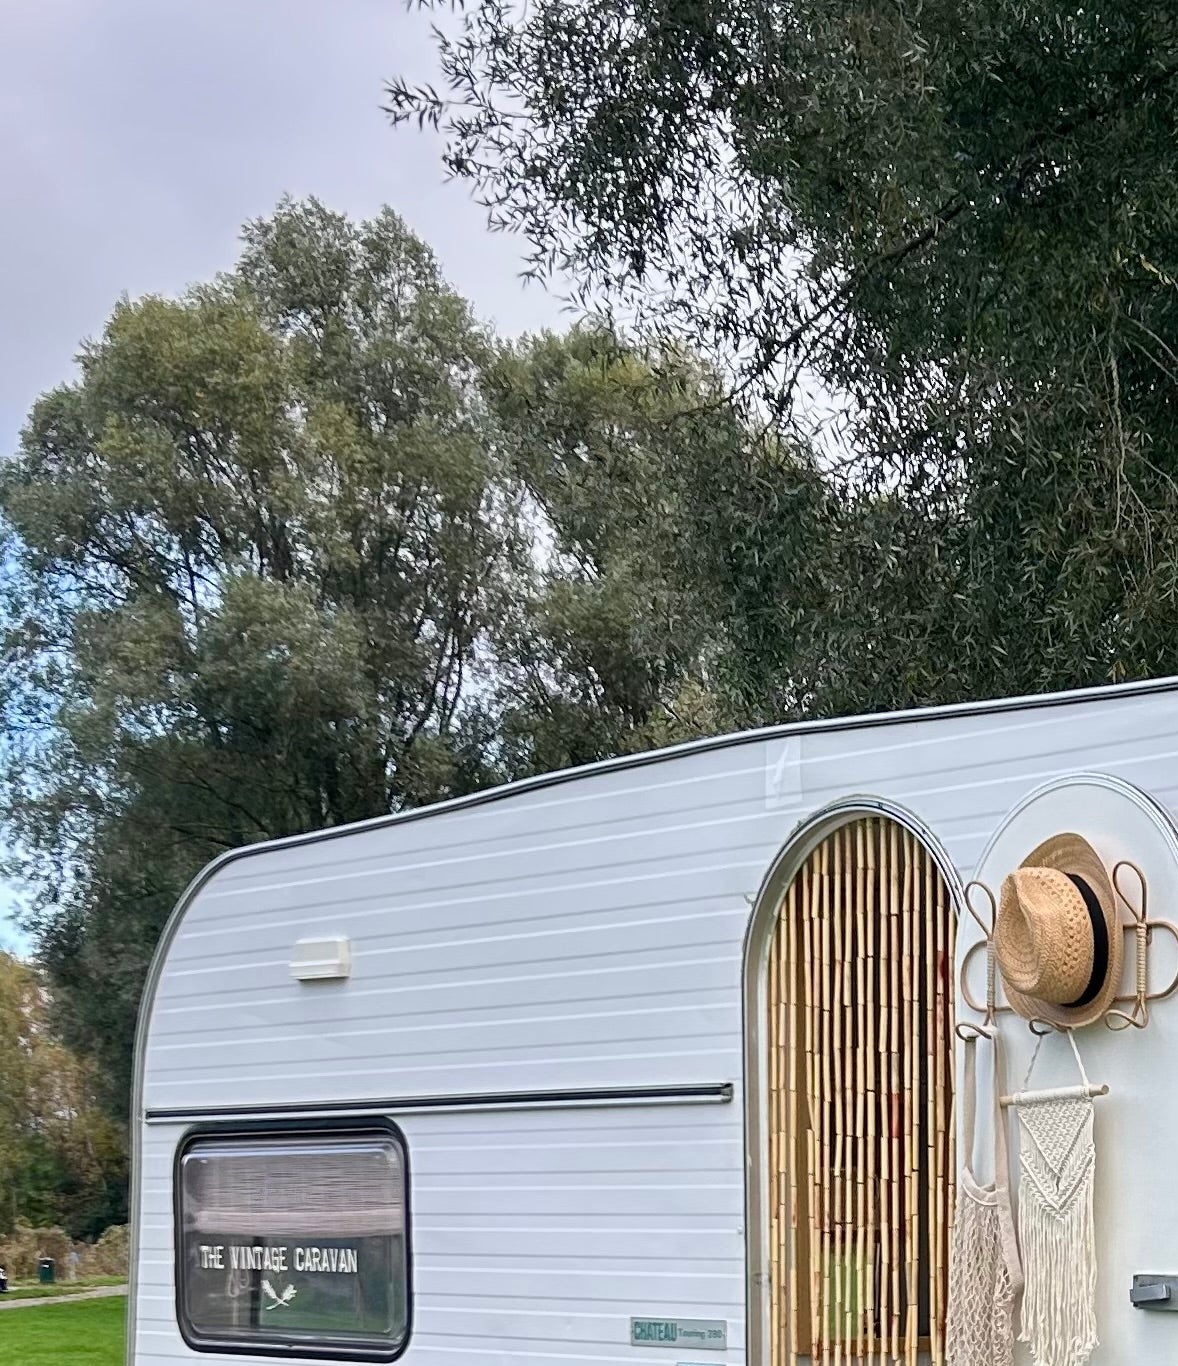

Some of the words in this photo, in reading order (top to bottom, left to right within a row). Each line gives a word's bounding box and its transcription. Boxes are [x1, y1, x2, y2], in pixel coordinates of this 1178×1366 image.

[200, 1245, 225, 1269] THE
[229, 1246, 288, 1271] VINTAGE
[294, 1247, 358, 1273] CARAVAN
[633, 1321, 678, 1341] CHATEAU
